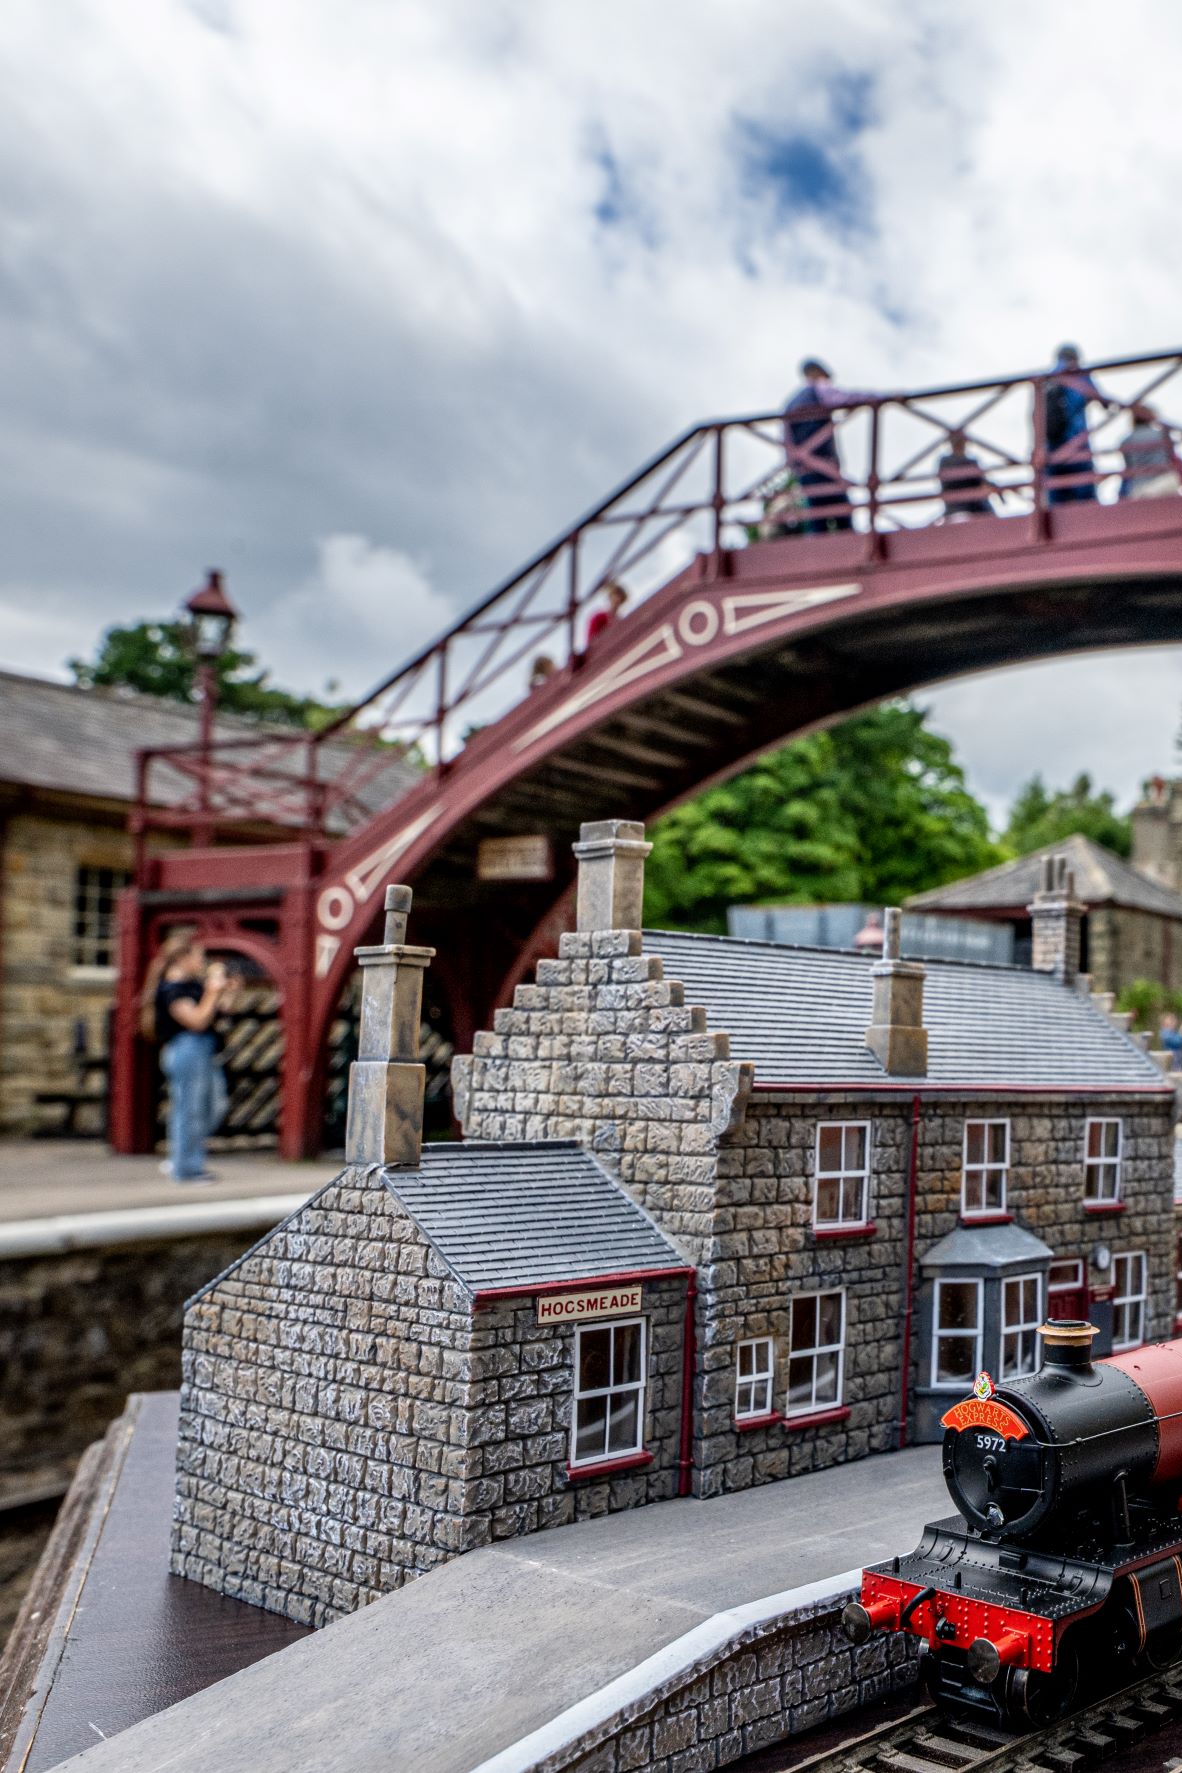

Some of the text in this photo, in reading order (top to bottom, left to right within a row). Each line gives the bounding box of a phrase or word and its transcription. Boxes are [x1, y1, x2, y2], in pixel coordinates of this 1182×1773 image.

[540, 1292, 639, 1317] HOGSMEADE
[954, 1402, 1012, 1426] HOGWARTS
[960, 1412, 1006, 1432] EXPRESS
[976, 1435, 1006, 1452] 5972
